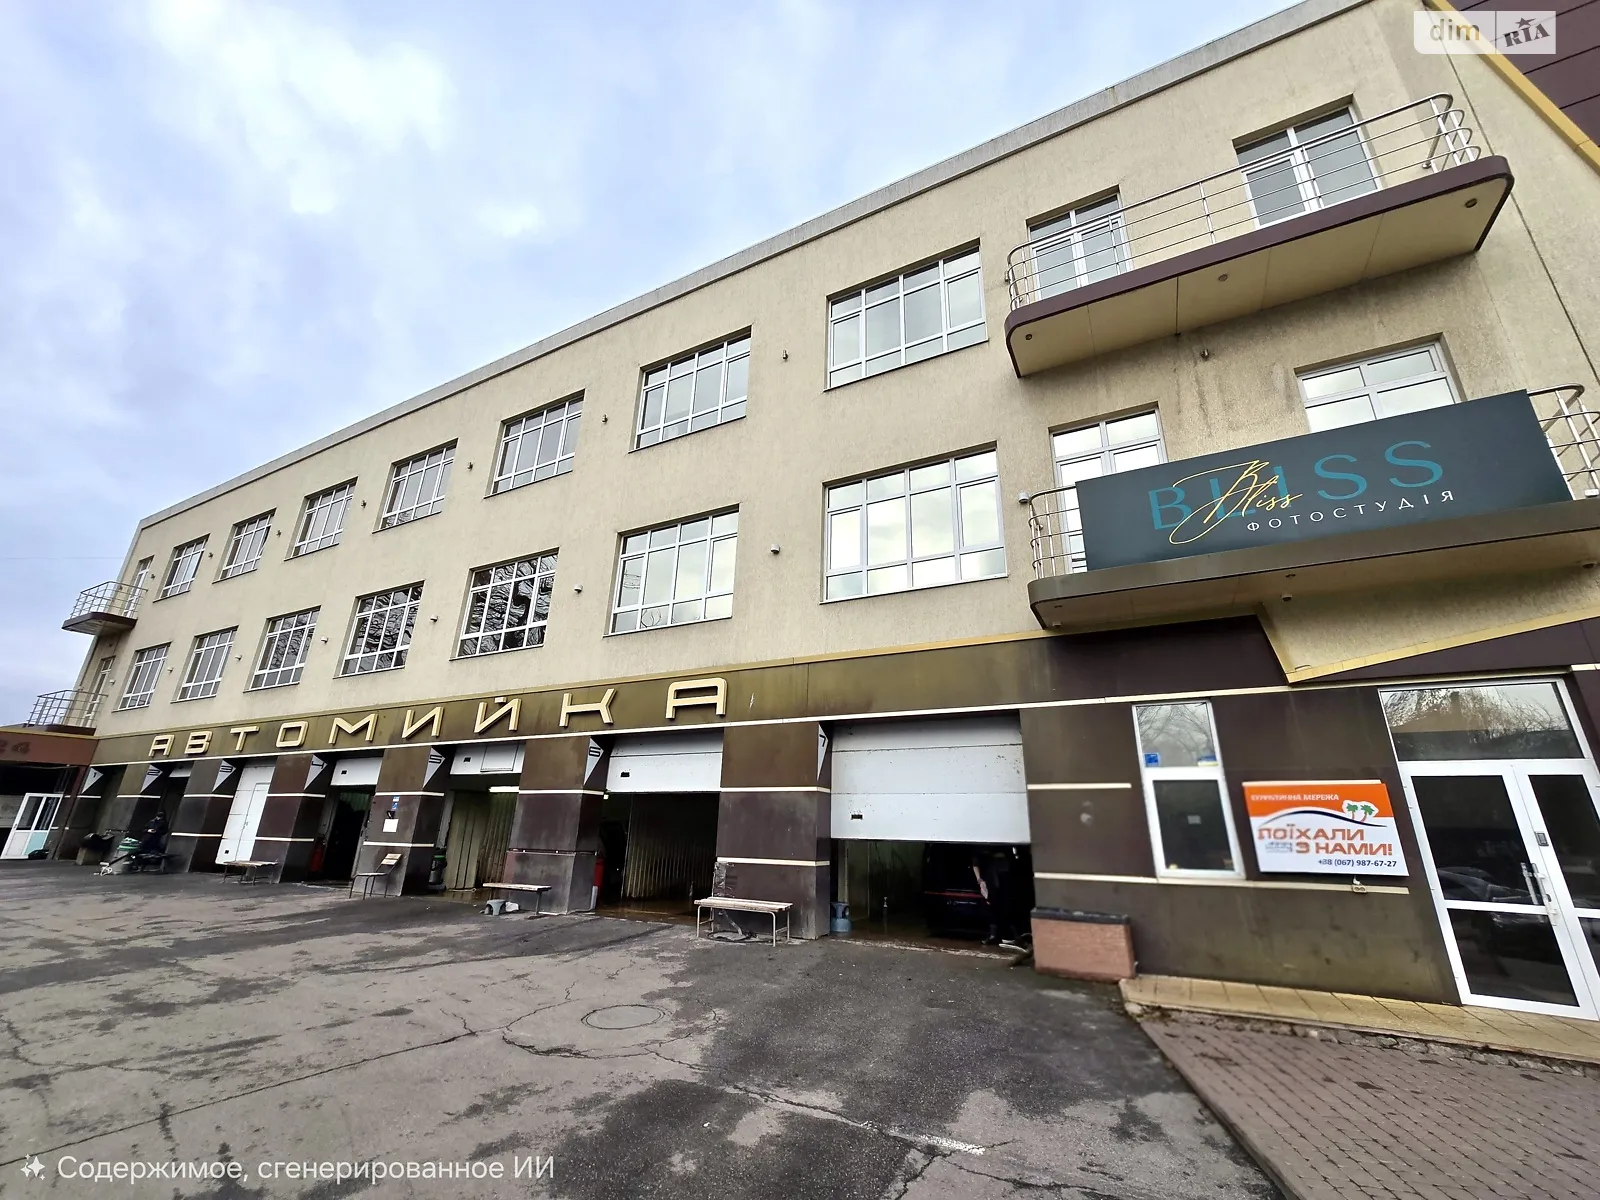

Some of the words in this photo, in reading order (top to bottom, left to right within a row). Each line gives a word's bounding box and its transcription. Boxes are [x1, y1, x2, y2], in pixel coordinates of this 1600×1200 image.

[1149, 441, 1443, 530] BLISS
[1169, 460, 1303, 545] Bliss
[1247, 490, 1454, 531] ФОТОСТУДІЯ
[148, 677, 728, 757] АВТОМИЙКА
[819, 733, 827, 747] 7
[589, 746, 601, 757] 6
[1258, 824, 1365, 841] ПОЇХАЛИ
[1315, 843, 1393, 856] НАМИ!
[1334, 859, 1355, 868] (067)
[1356, 860, 1397, 868] 987-67-27
